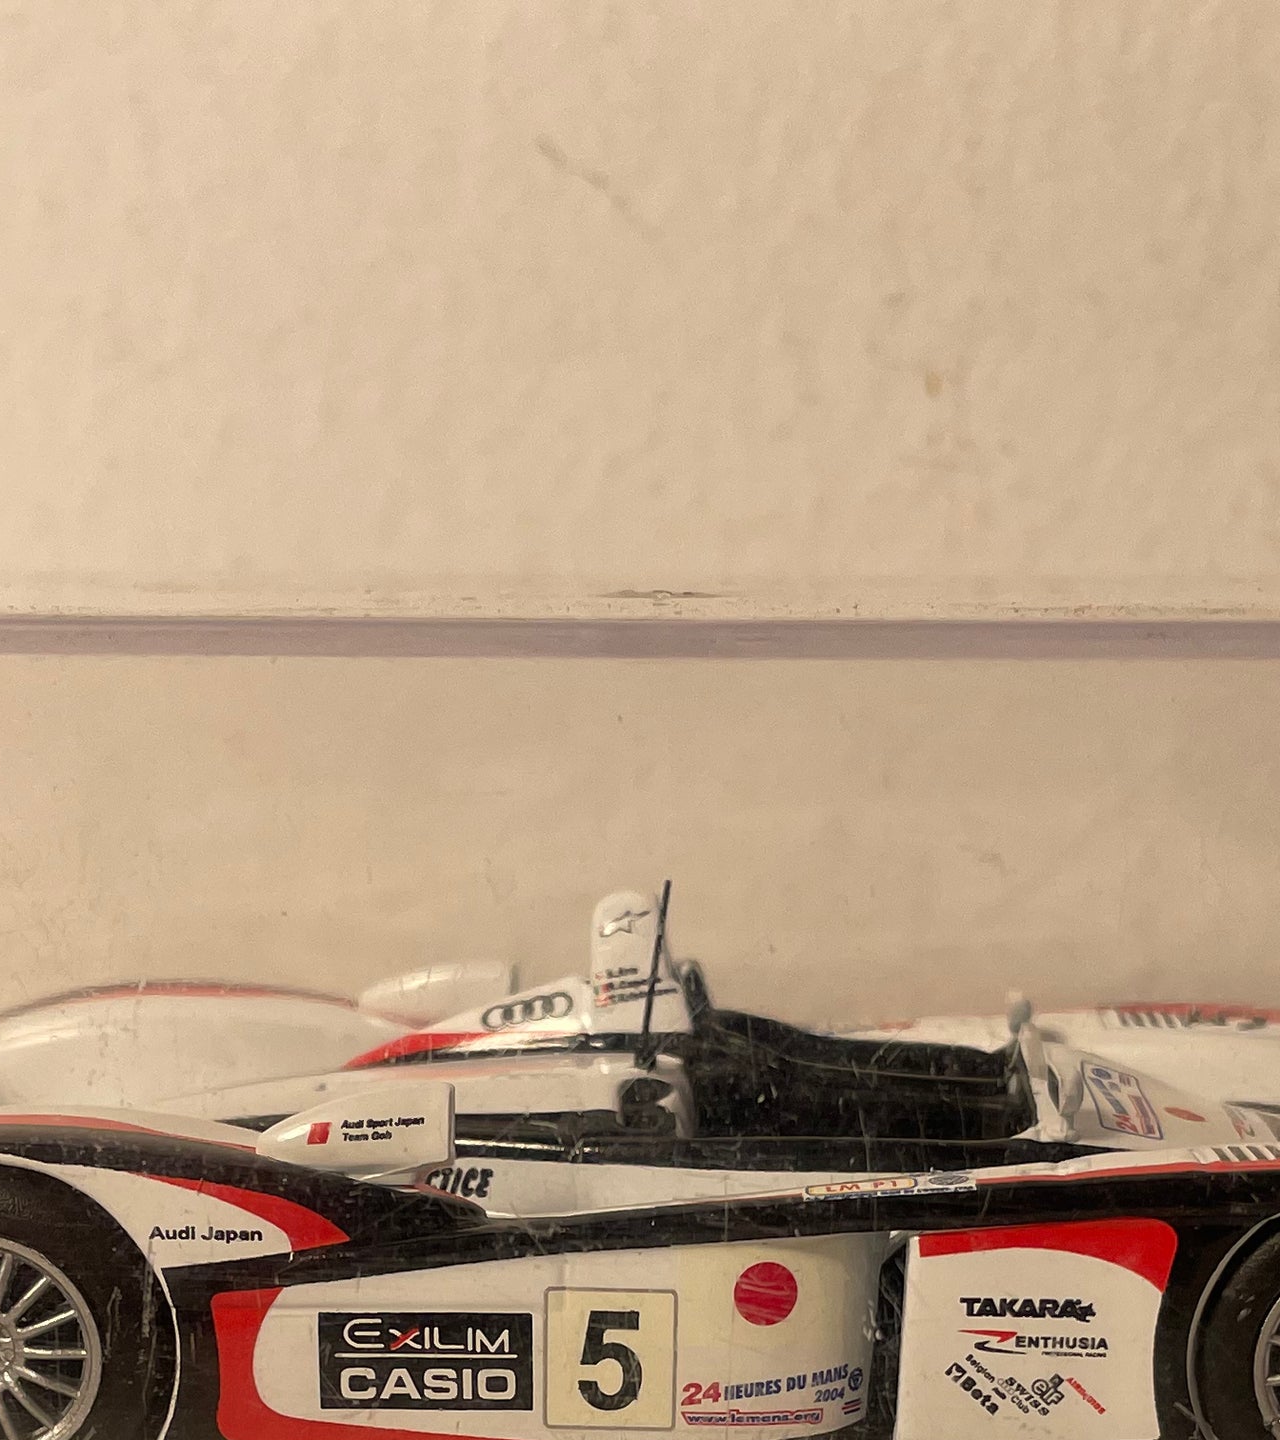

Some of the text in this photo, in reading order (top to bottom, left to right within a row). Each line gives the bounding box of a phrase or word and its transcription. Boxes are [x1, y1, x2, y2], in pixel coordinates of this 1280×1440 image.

[341, 1119, 365, 1130] Audi
[366, 1118, 393, 1130] Sport
[342, 1132, 369, 1142] Team
[149, 1225, 263, 1244] Audi Japan
[959, 1296, 1080, 1319] TAKARA
[1014, 1335, 1109, 1350] ENTHUSIA
[577, 1310, 642, 1411] 5
[339, 1367, 517, 1401] CASIO
[680, 1363, 849, 1407] 24 HEURES DU MANS
[813, 1386, 846, 1404] 2004
[960, 1376, 1000, 1416] Beta
[1010, 1396, 1030, 1414] Club
